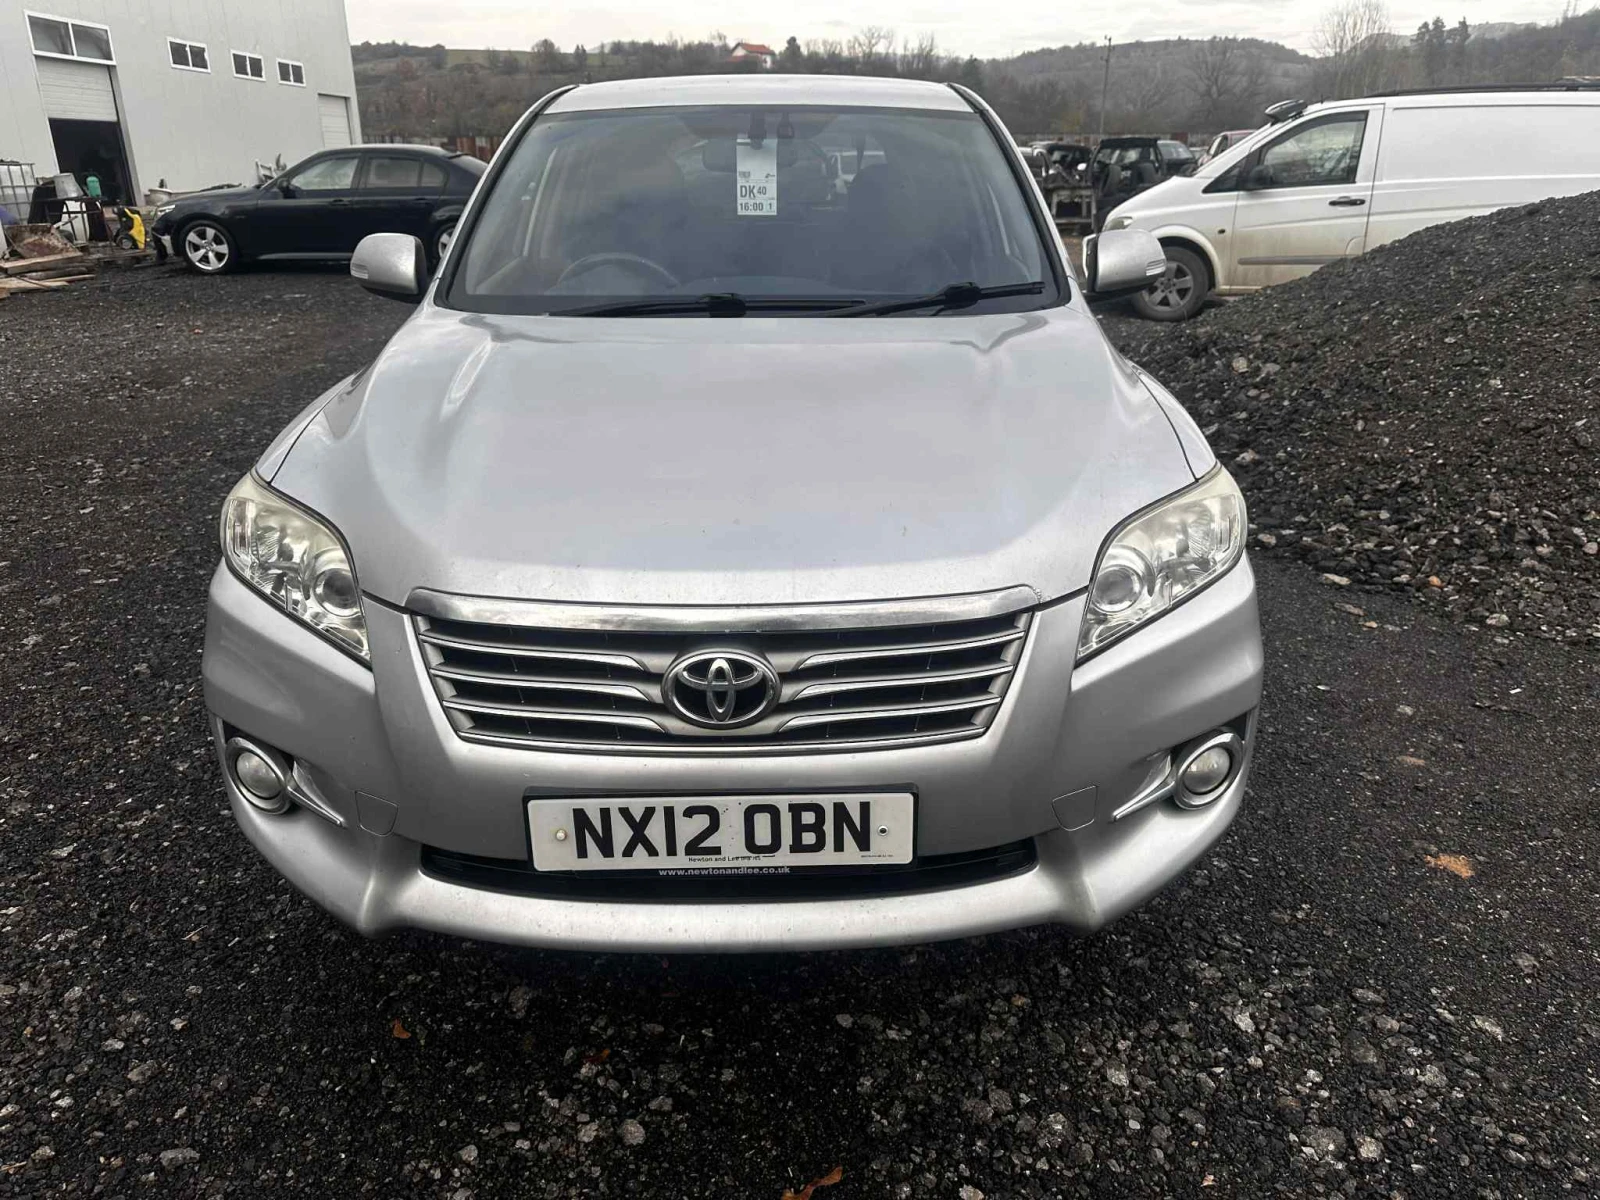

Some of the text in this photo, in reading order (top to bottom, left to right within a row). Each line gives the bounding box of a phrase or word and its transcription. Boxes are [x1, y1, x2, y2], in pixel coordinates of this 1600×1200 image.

[739, 185, 767, 199] DK 40
[739, 202, 764, 212] 16:00
[571, 805, 722, 859] NX12
[658, 866, 791, 877] www.newtonandlee.co.uk
